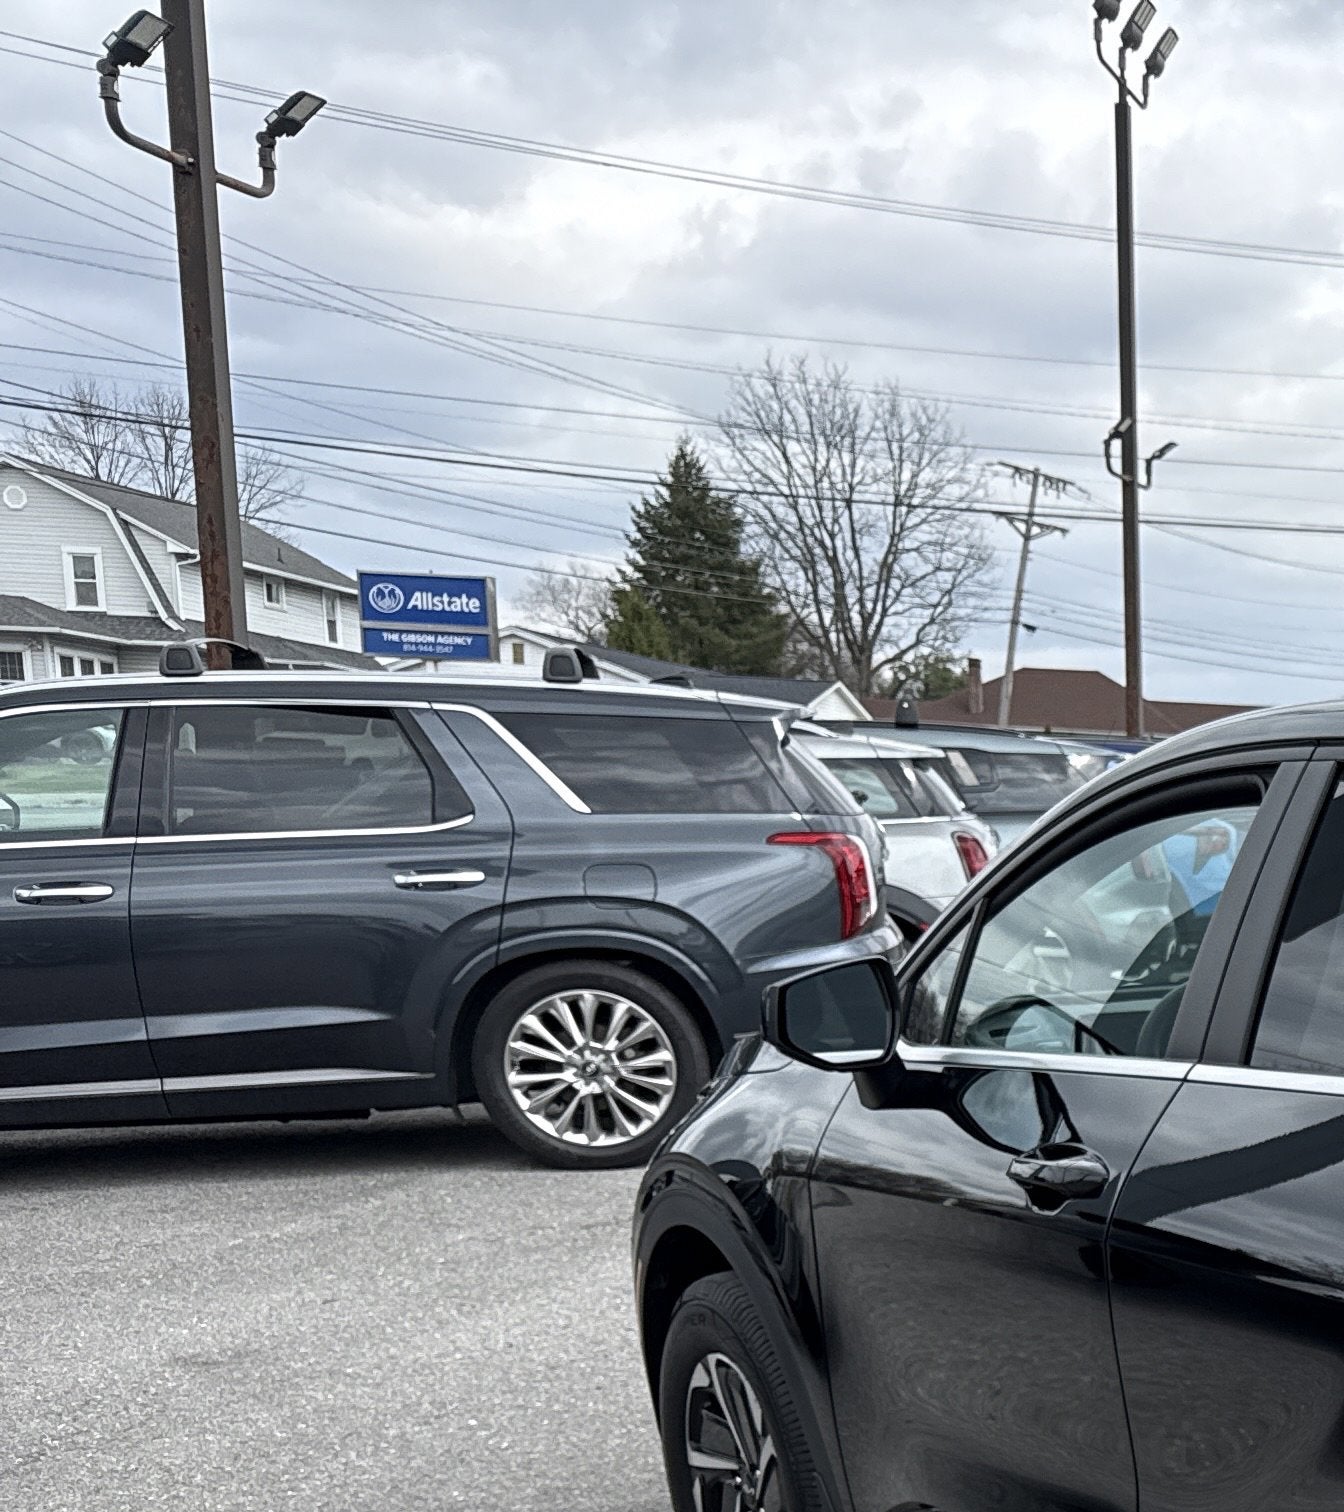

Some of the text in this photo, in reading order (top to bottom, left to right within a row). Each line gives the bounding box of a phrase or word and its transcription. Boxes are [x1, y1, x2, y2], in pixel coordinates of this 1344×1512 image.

[406, 590, 481, 613] Allstate
[382, 631, 473, 646] THE GIBSON AGENCY
